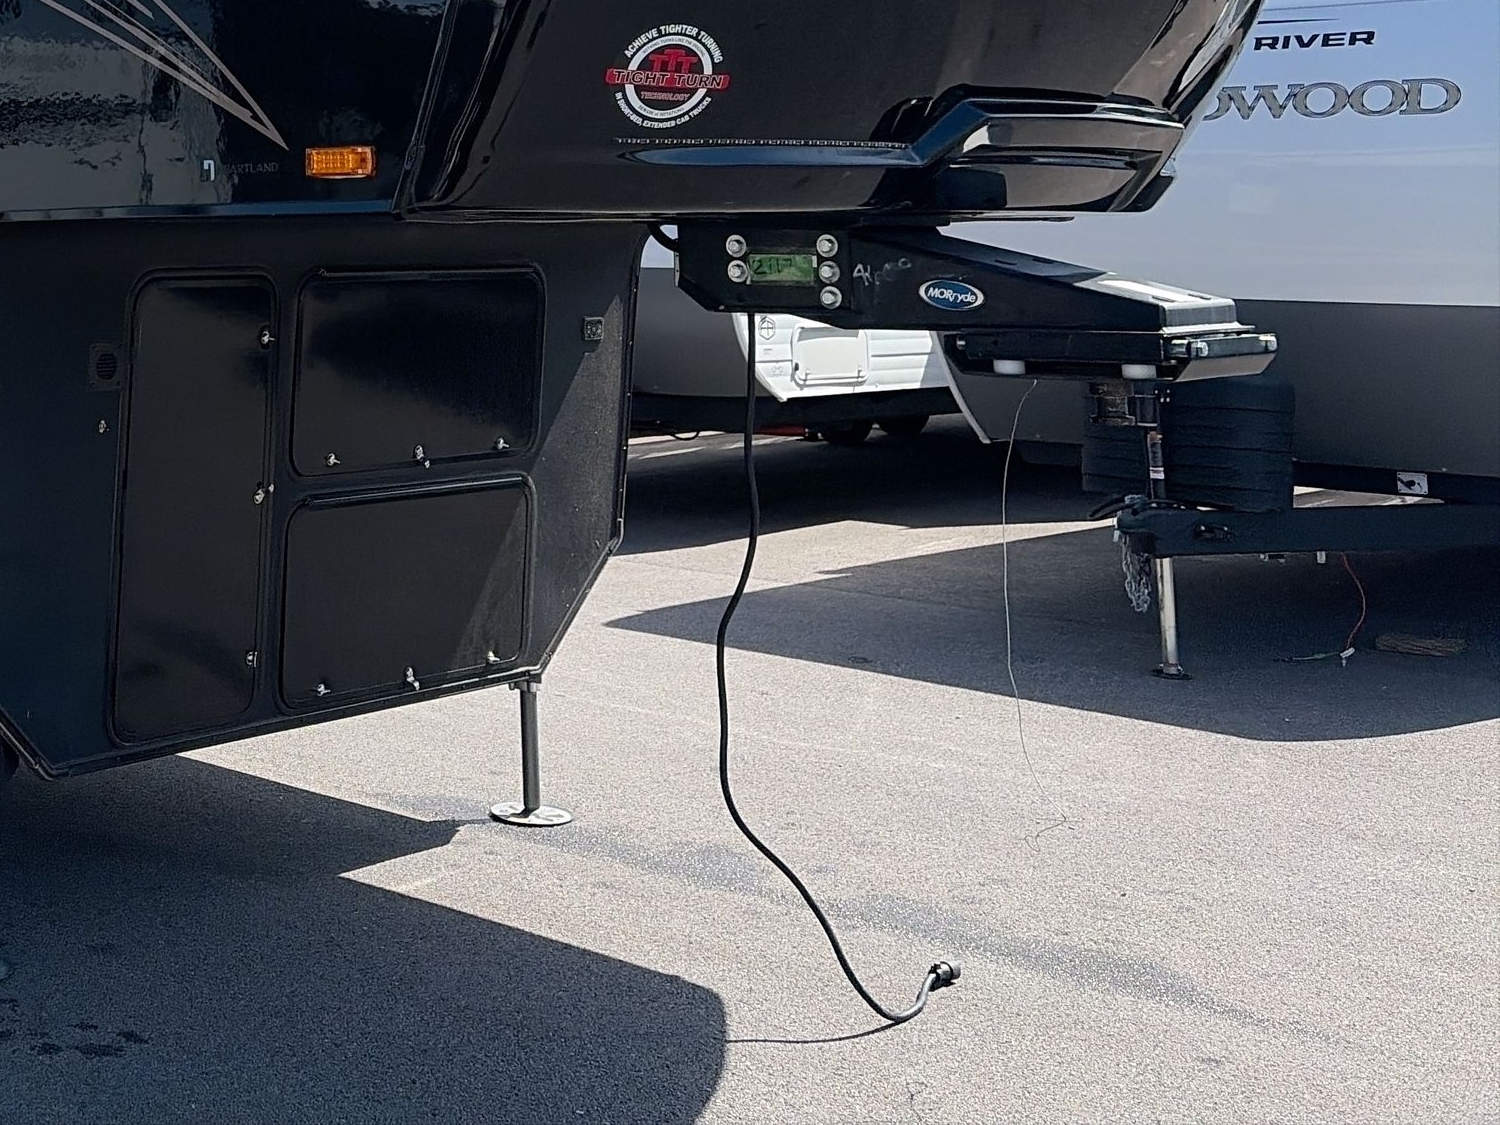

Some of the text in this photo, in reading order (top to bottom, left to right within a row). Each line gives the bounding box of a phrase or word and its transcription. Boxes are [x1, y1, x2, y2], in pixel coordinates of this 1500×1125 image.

[624, 24, 723, 63] ACHIEVE TIGHTER TURNING
[1253, 30, 1375, 51] RIVER
[613, 69, 723, 89] TIGHT TURN
[643, 120, 676, 129] EXTENDED
[676, 115, 690, 125] CAB
[688, 96, 712, 118] TRUCKS
[927, 286, 977, 304] MORryde
